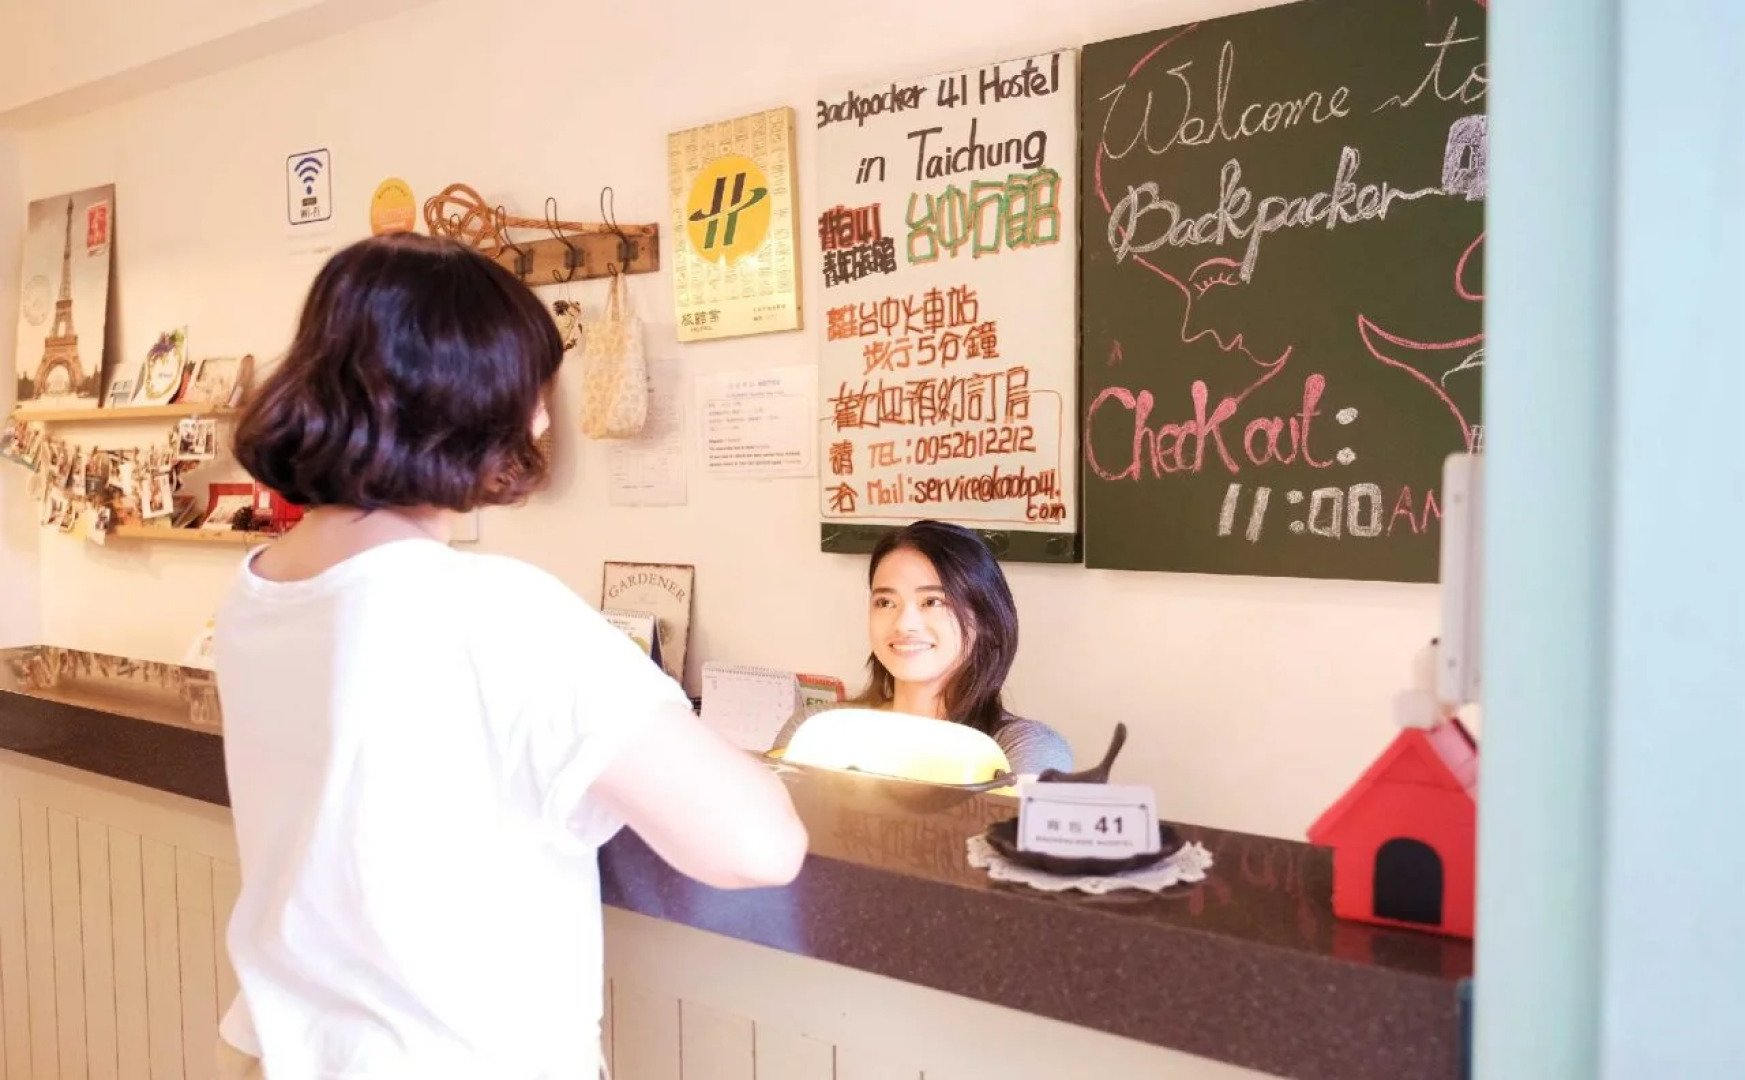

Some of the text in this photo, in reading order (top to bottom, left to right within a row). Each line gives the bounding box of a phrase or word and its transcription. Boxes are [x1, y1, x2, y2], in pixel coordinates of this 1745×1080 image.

[937, 75, 968, 108] 41
[980, 53, 1060, 105] Hostel
[1099, 41, 1351, 158] Welcome
[1372, 16, 1488, 113] to
[855, 118, 1048, 184] in Taichung
[1107, 146, 1444, 284] Backpacker
[826, 284, 979, 342] 離台中火車站
[863, 321, 1000, 375] 步行5分鐘
[827, 366, 1032, 432] 歡迎預約訂房
[1086, 380, 1239, 482] Check
[1218, 483, 1383, 544] 11:00
[608, 573, 686, 604] GARDENER
[1095, 816, 1122, 834] 41
